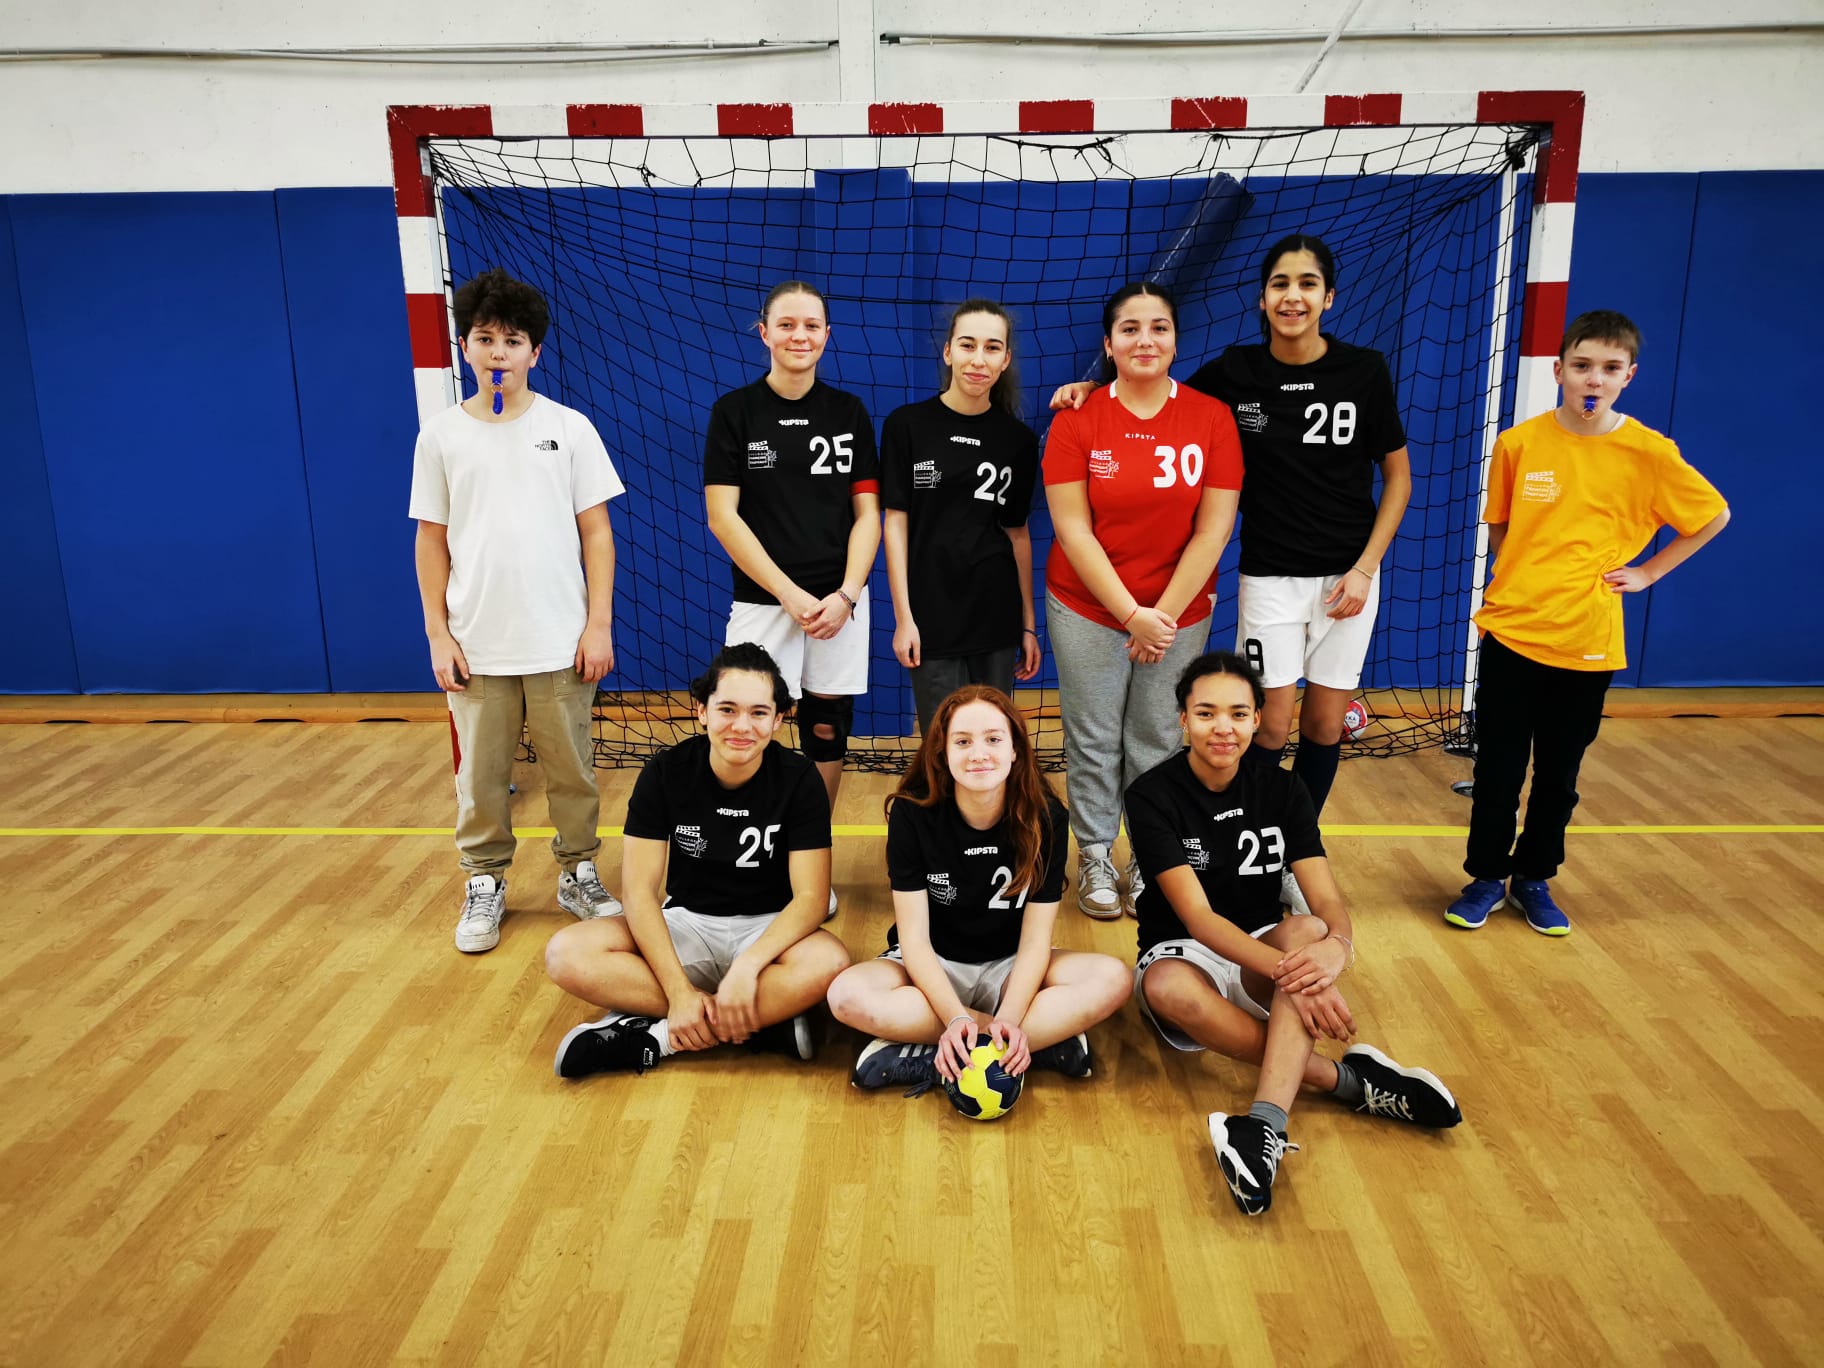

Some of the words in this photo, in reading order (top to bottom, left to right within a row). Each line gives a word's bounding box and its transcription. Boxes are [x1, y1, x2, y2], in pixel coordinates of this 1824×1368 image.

[1124, 432, 1156, 441] KIPSTA
[1302, 401, 1357, 446] 28
[809, 432, 854, 475] 25
[1152, 443, 1204, 489] 30
[973, 461, 1012, 506] 22
[1237, 826, 1286, 876] 23
